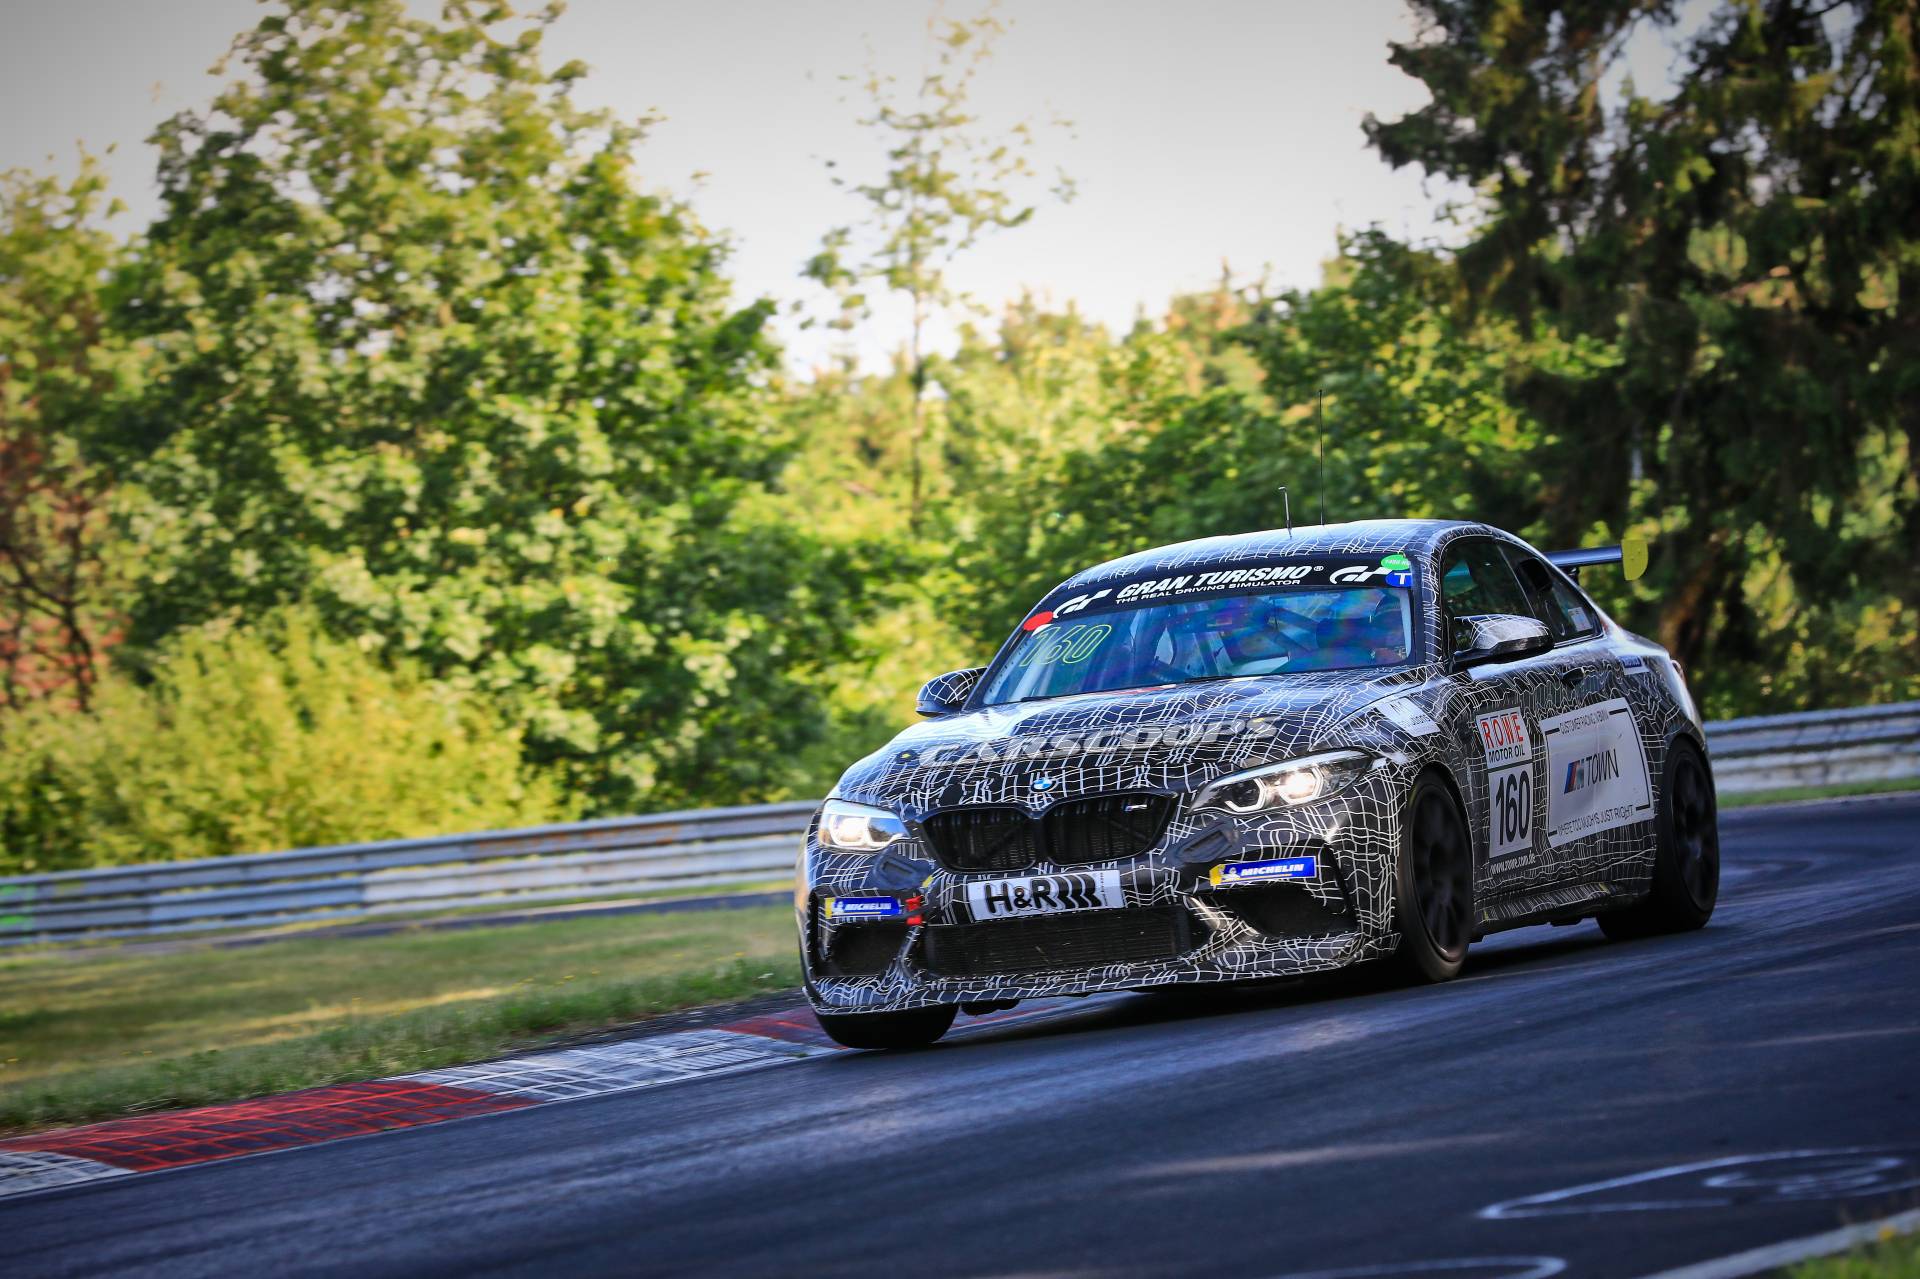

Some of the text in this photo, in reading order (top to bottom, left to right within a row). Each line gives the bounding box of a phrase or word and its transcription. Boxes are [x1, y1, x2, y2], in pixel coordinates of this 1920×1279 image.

[1116, 579, 1300, 604] THE REAL DRIVING SIMULATOR
[1117, 575, 1193, 598] GRAN
[1019, 624, 1112, 667] 160
[1480, 712, 1524, 749] ROWE
[1489, 746, 1525, 763] MOTOR OIL
[1586, 749, 1619, 786] TOWN
[1496, 771, 1530, 845] 160
[1614, 804, 1633, 820] RIGHT
[1241, 863, 1304, 876] MICHELIN
[844, 902, 892, 911] MICHELIN
[984, 878, 1059, 914] H&R
